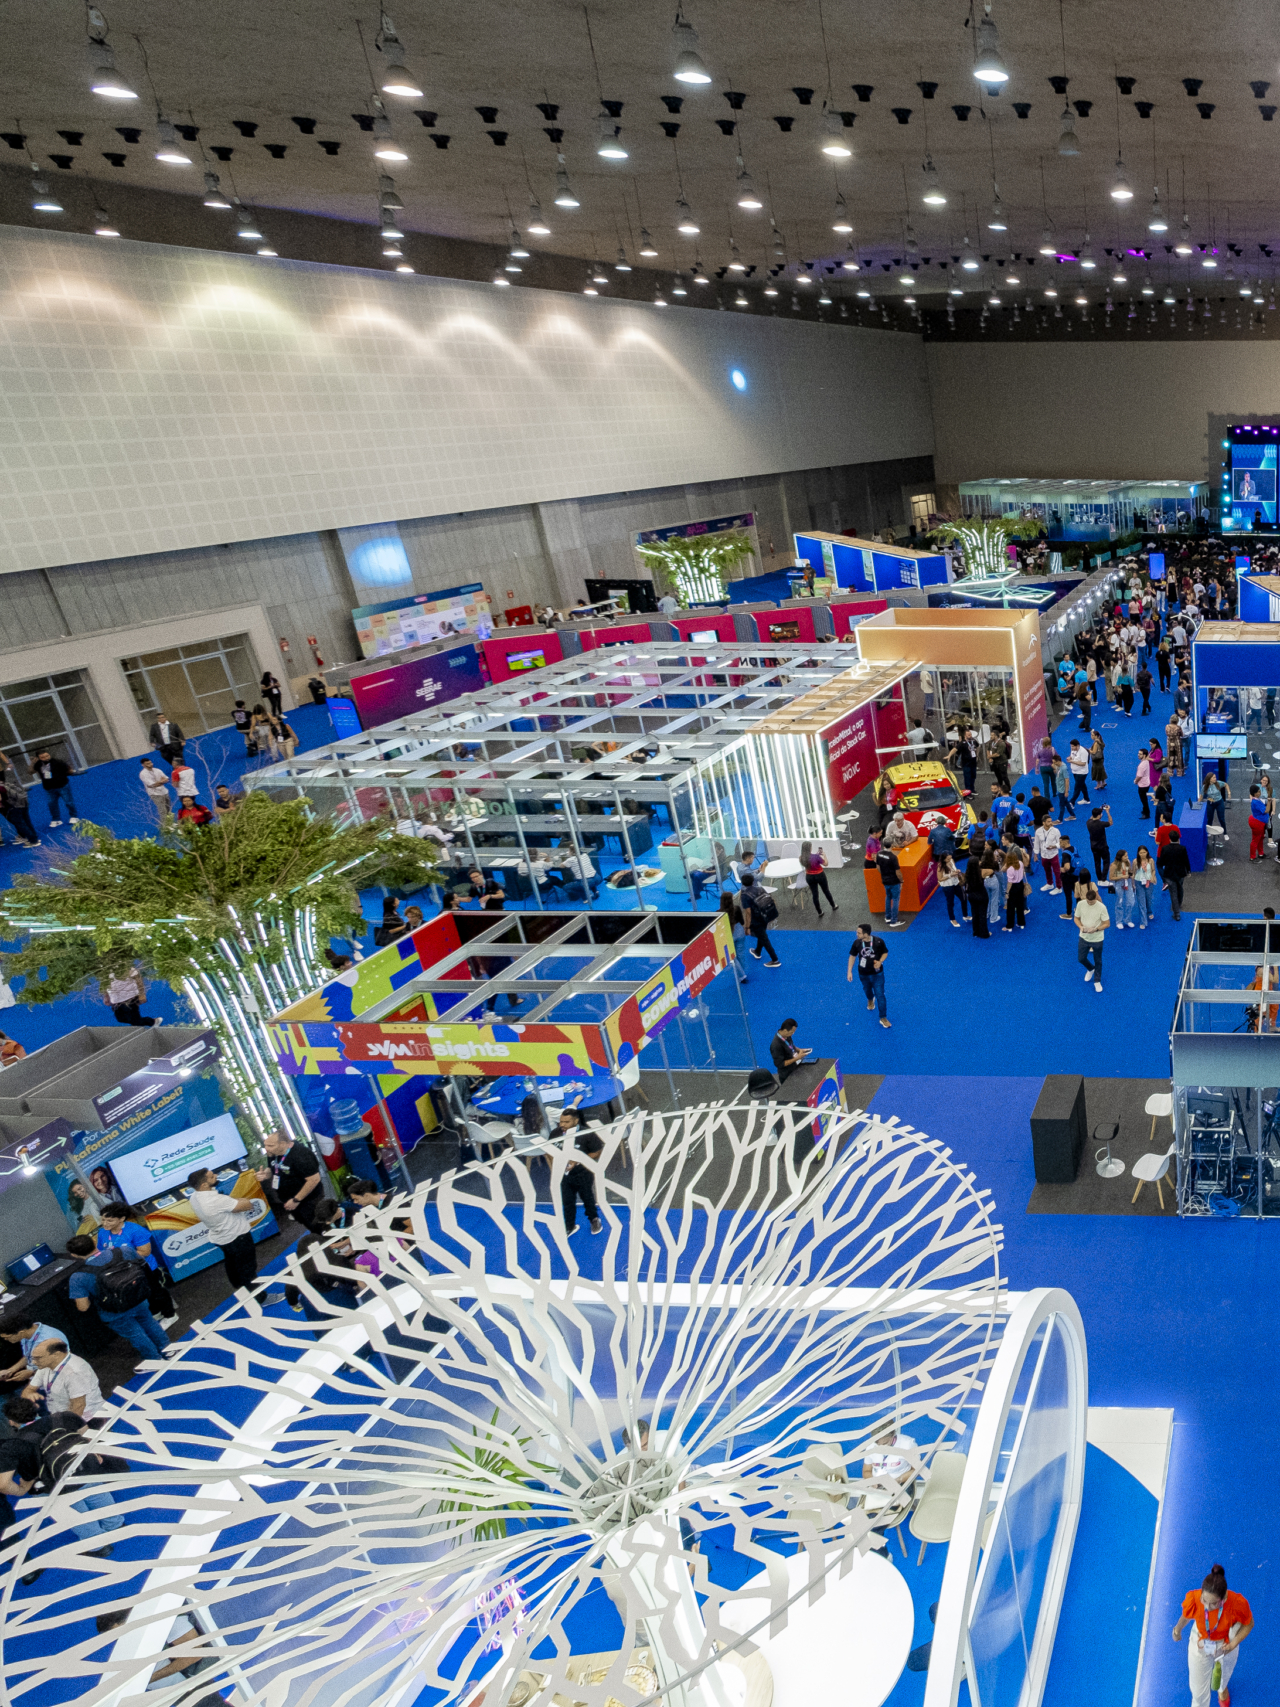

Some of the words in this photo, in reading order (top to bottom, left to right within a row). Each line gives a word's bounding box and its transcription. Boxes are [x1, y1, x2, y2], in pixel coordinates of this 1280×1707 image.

[416, 682, 442, 697] SEBRAE
[829, 726, 852, 749] rcelorMittal,
[642, 956, 712, 1028] COWORKING
[55, 1130, 120, 1175] Pltaforma
[119, 1108, 152, 1133] White
[151, 1086, 184, 1112] Label?
[82, 1132, 100, 1145] Por
